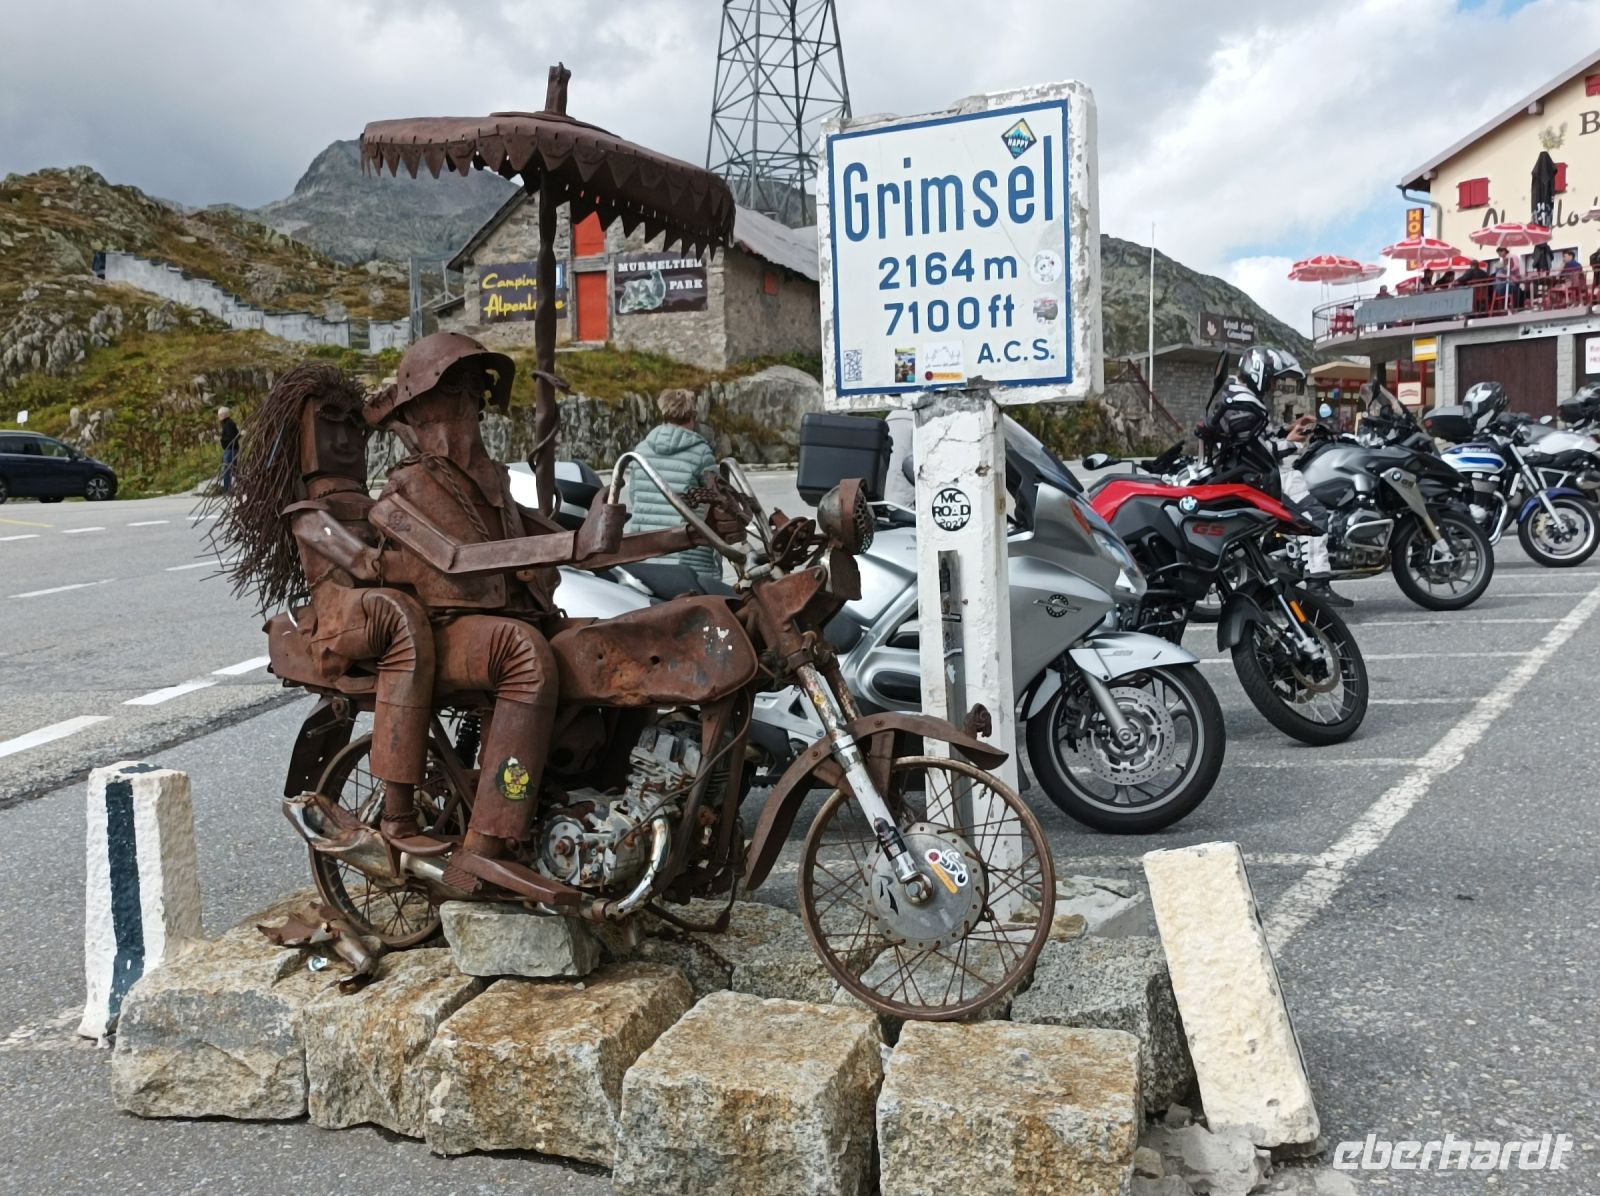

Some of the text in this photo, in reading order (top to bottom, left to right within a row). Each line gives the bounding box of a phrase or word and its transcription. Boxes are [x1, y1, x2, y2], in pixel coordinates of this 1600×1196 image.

[1008, 138, 1029, 149] HAPPY
[842, 136, 1053, 242] Grimsel
[617, 258, 703, 272] MURMELTIER
[878, 249, 1018, 290] 2164 m
[669, 279, 703, 290] PARK
[884, 294, 1014, 336] 7100 ft
[977, 338, 1055, 364] A.C.S.
[940, 491, 963, 503] MC
[932, 505, 970, 517] ROAD
[1192, 522, 1224, 536] GS
